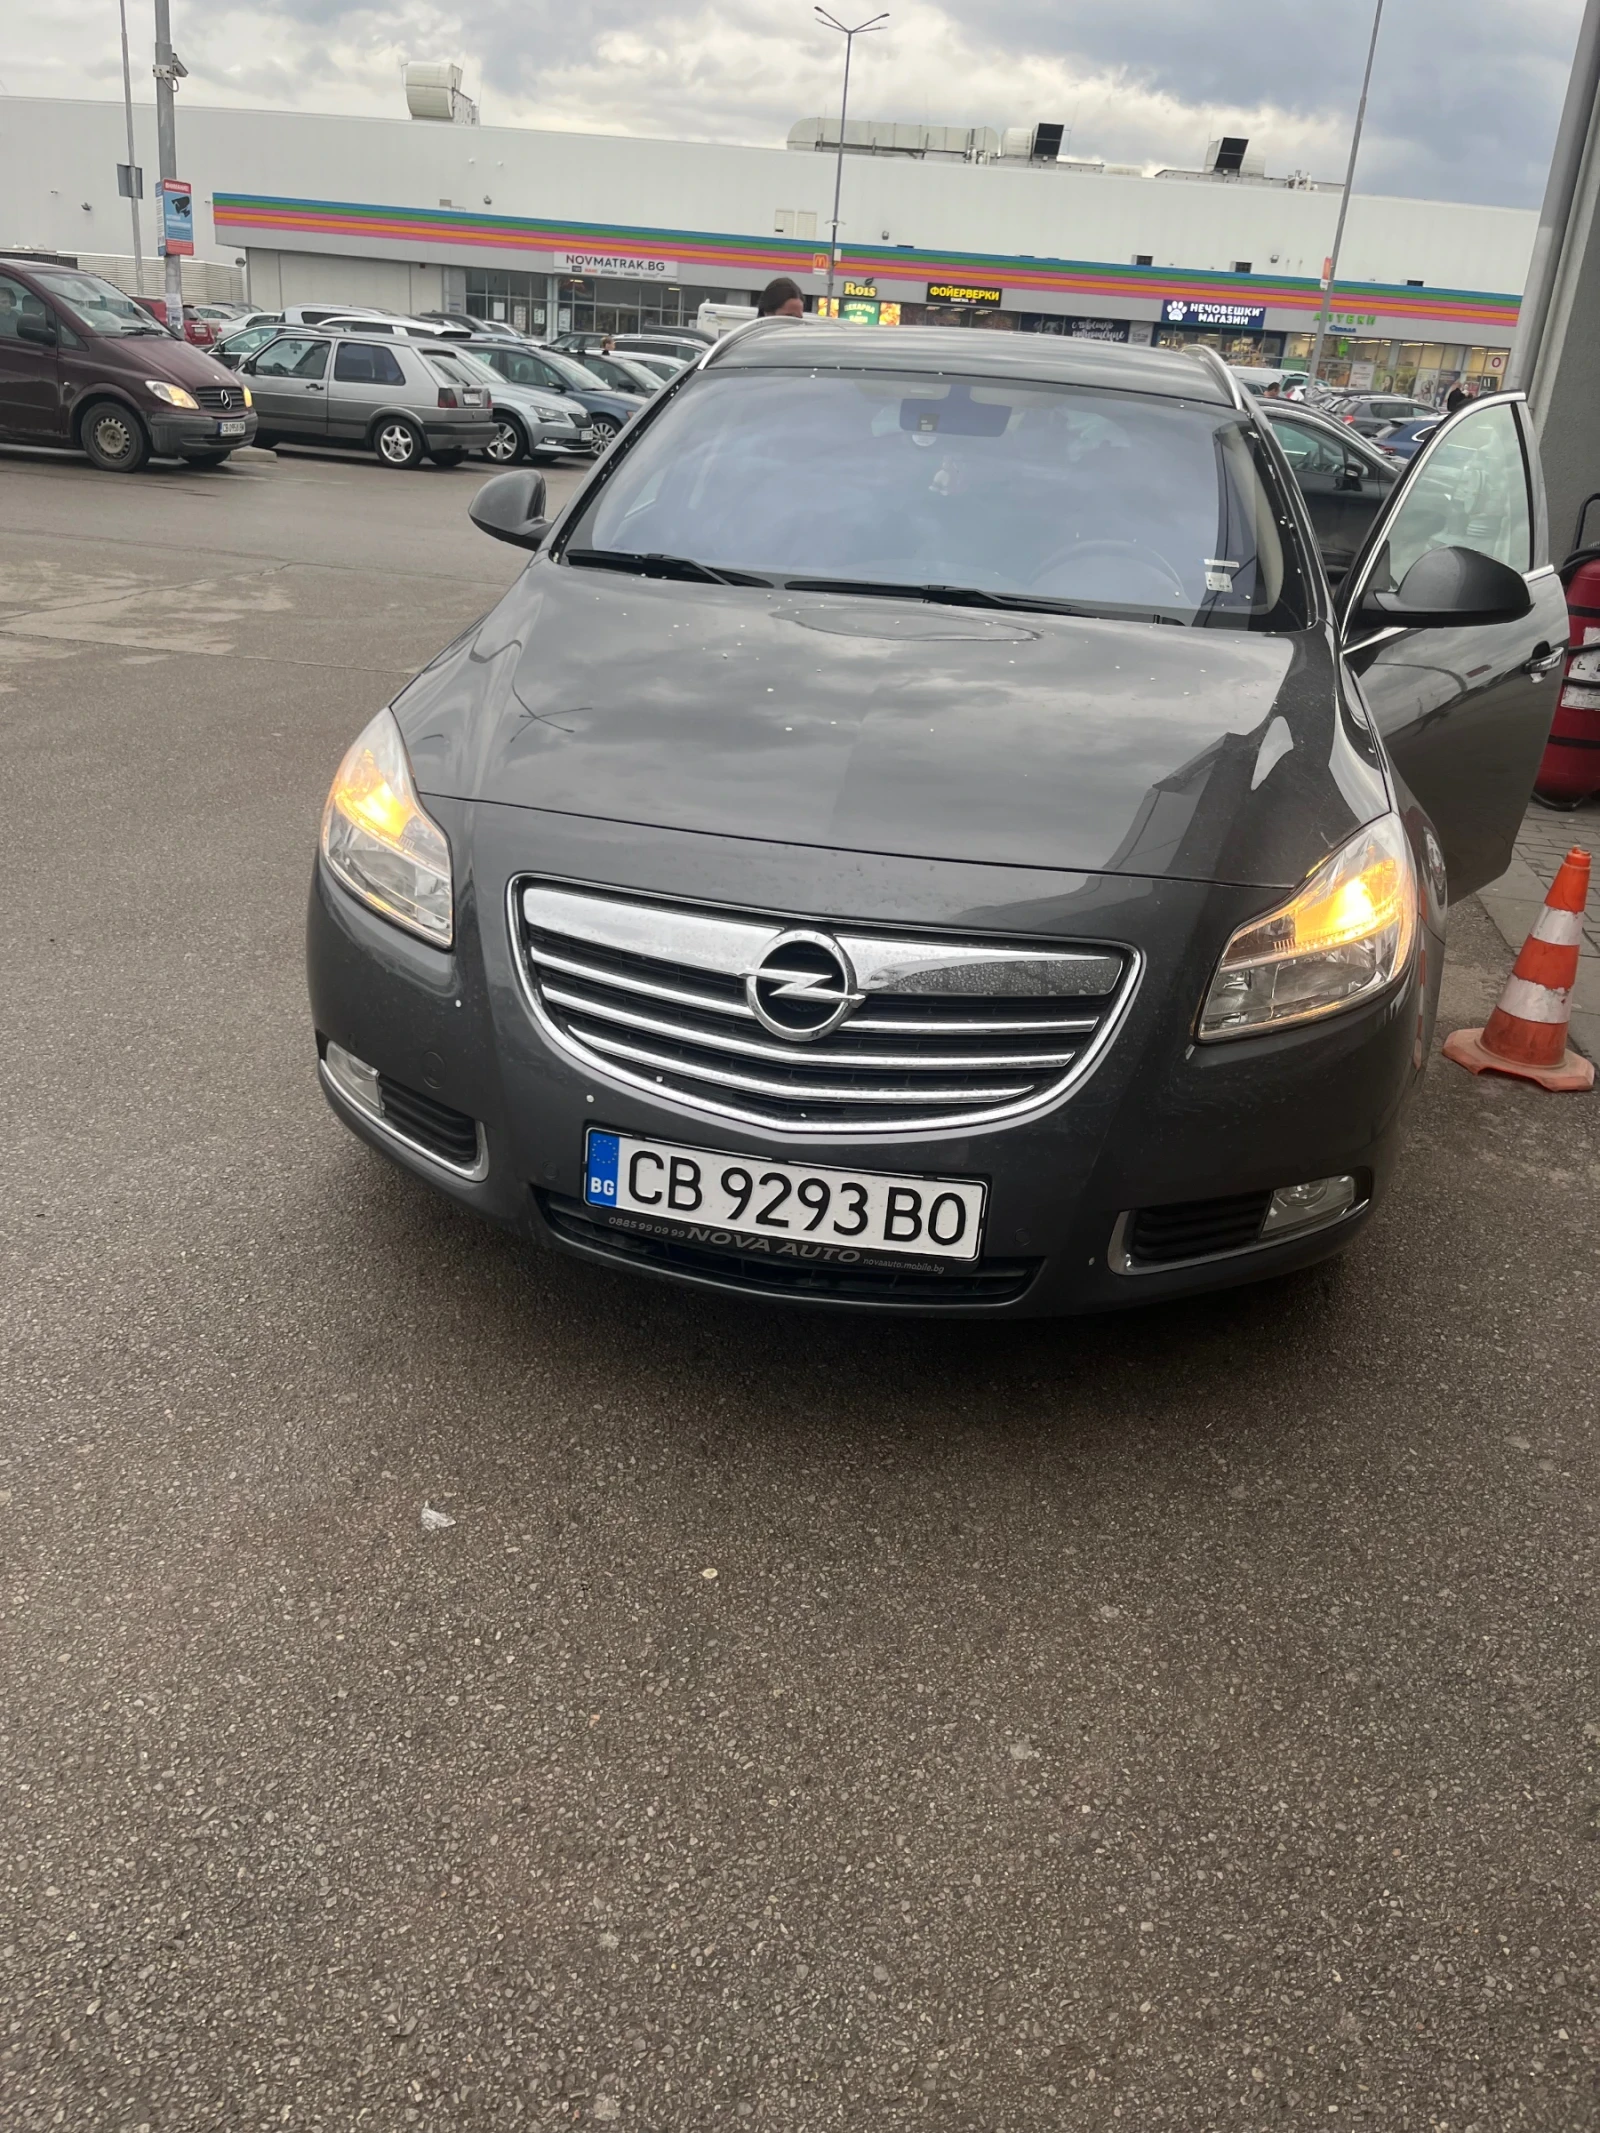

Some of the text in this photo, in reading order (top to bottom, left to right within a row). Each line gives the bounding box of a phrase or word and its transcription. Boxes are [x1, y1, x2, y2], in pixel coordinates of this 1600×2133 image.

[566, 254, 665, 271] NOVMATRAK.BG
[843, 281, 877, 297] Rois
[930, 285, 1000, 300] ФОЙЕРВЕРКИ
[1190, 303, 1260, 317] НЕЧОВЕШКИ
[1198, 313, 1249, 325] МАГАЗИН
[590, 1176, 615, 1196] BG
[628, 1150, 967, 1246] CB 9293 BO
[608, 1216, 945, 1275] 0885 99 09 99 NOVA AUTO novaauto.mobile.bg
